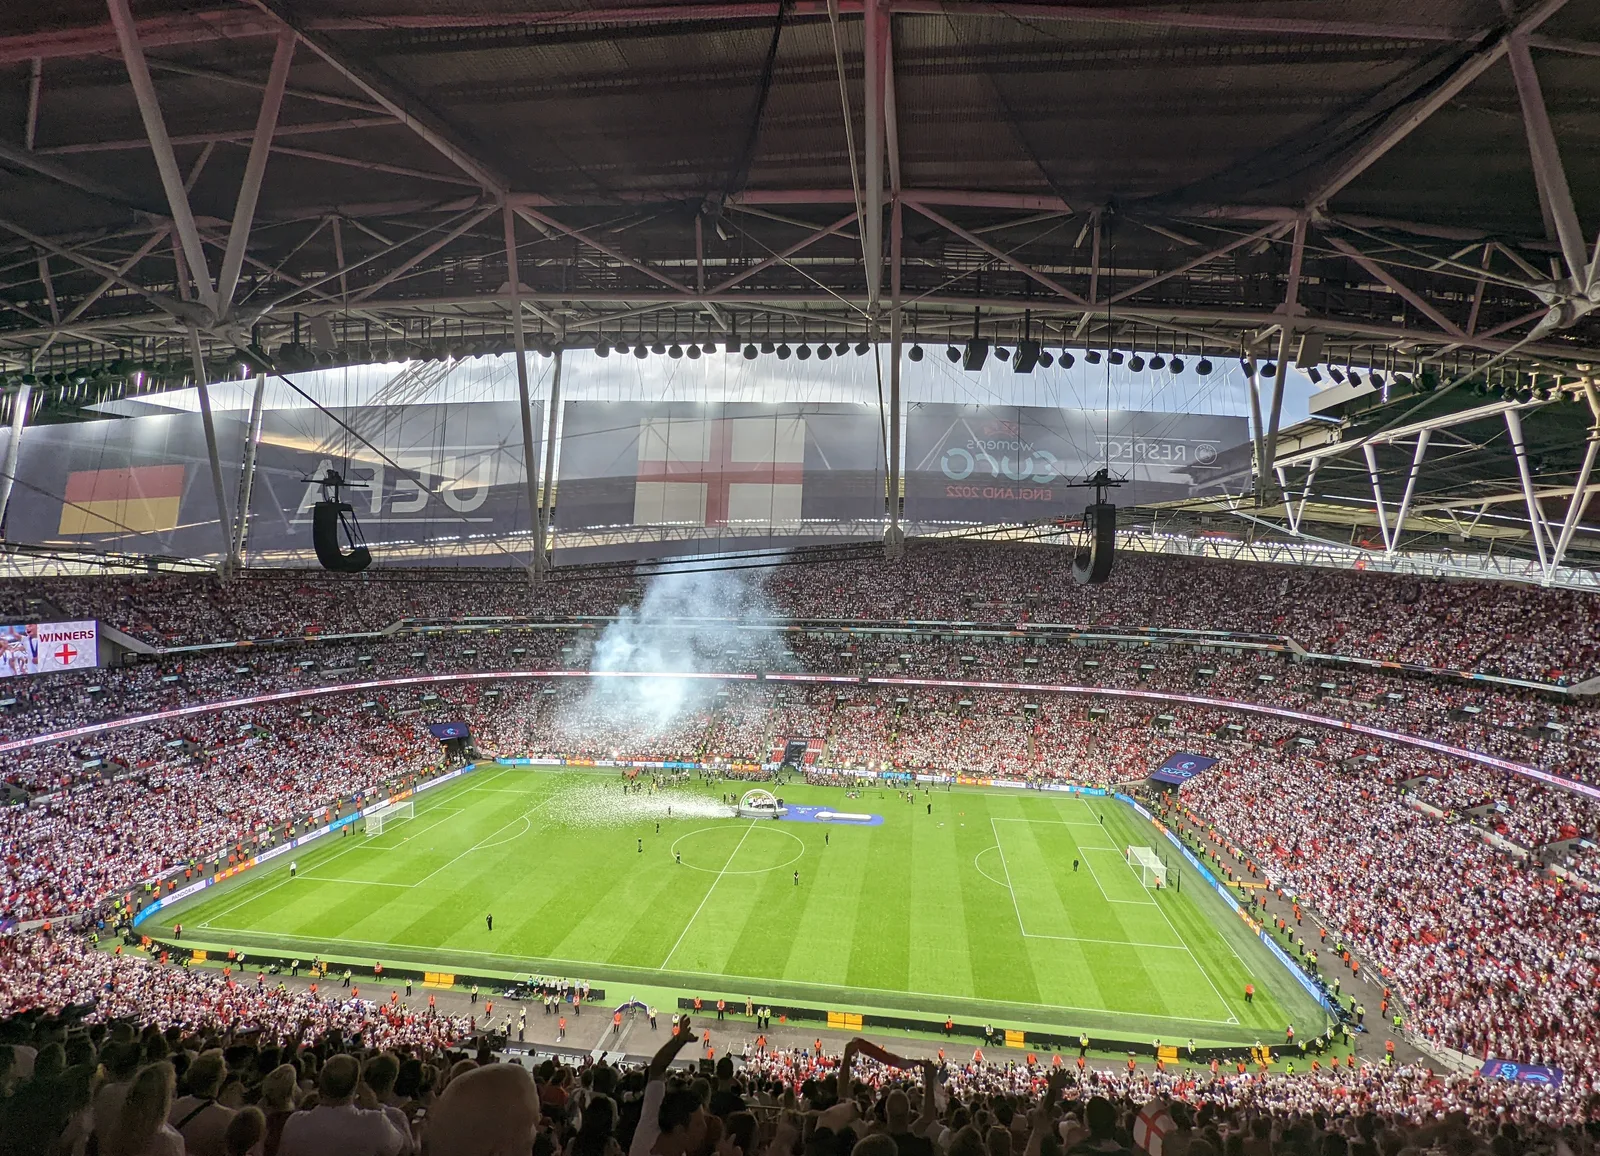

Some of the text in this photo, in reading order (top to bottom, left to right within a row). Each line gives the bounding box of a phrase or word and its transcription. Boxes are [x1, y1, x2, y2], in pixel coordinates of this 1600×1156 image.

[39, 630, 94, 642] WINNERS
[53, 729, 79, 738] WINNERS
[1498, 760, 1523, 773] WINNERS
[1551, 776, 1577, 789] WINNERS
